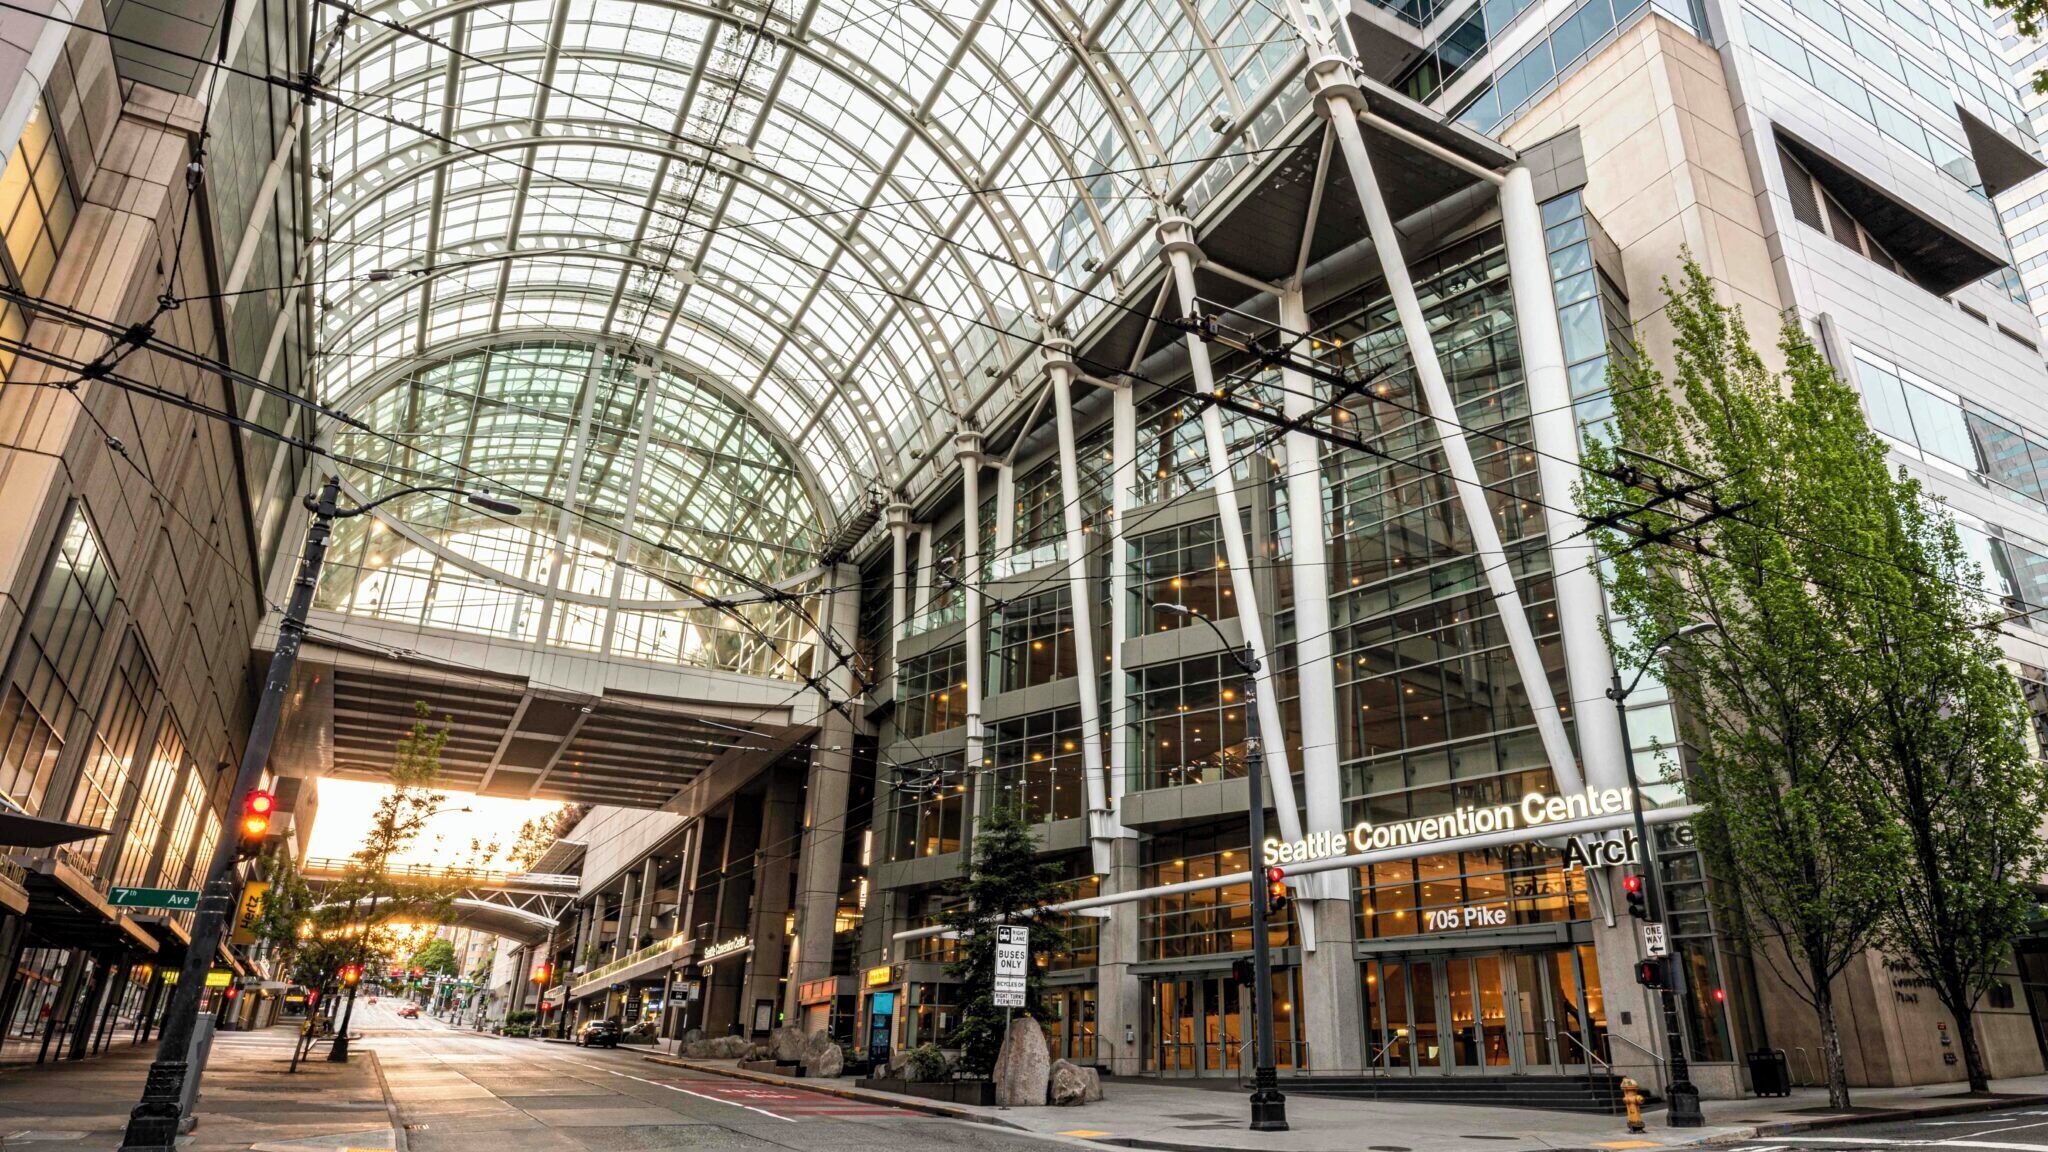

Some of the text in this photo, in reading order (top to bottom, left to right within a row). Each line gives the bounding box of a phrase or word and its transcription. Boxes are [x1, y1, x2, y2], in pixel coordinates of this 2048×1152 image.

[1263, 830, 1347, 866] Seattle
[1353, 805, 1514, 852] Convention
[1521, 785, 1633, 825] Center
[116, 889, 190, 905] 7th Ave
[240, 895, 259, 928] Hertz
[1426, 906, 1506, 930] 705 Pike
[1646, 926, 1661, 935] ONE
[1646, 935, 1662, 944] WAY
[999, 950, 1025, 959] BUSES
[1001, 960, 1022, 968] ONLY
